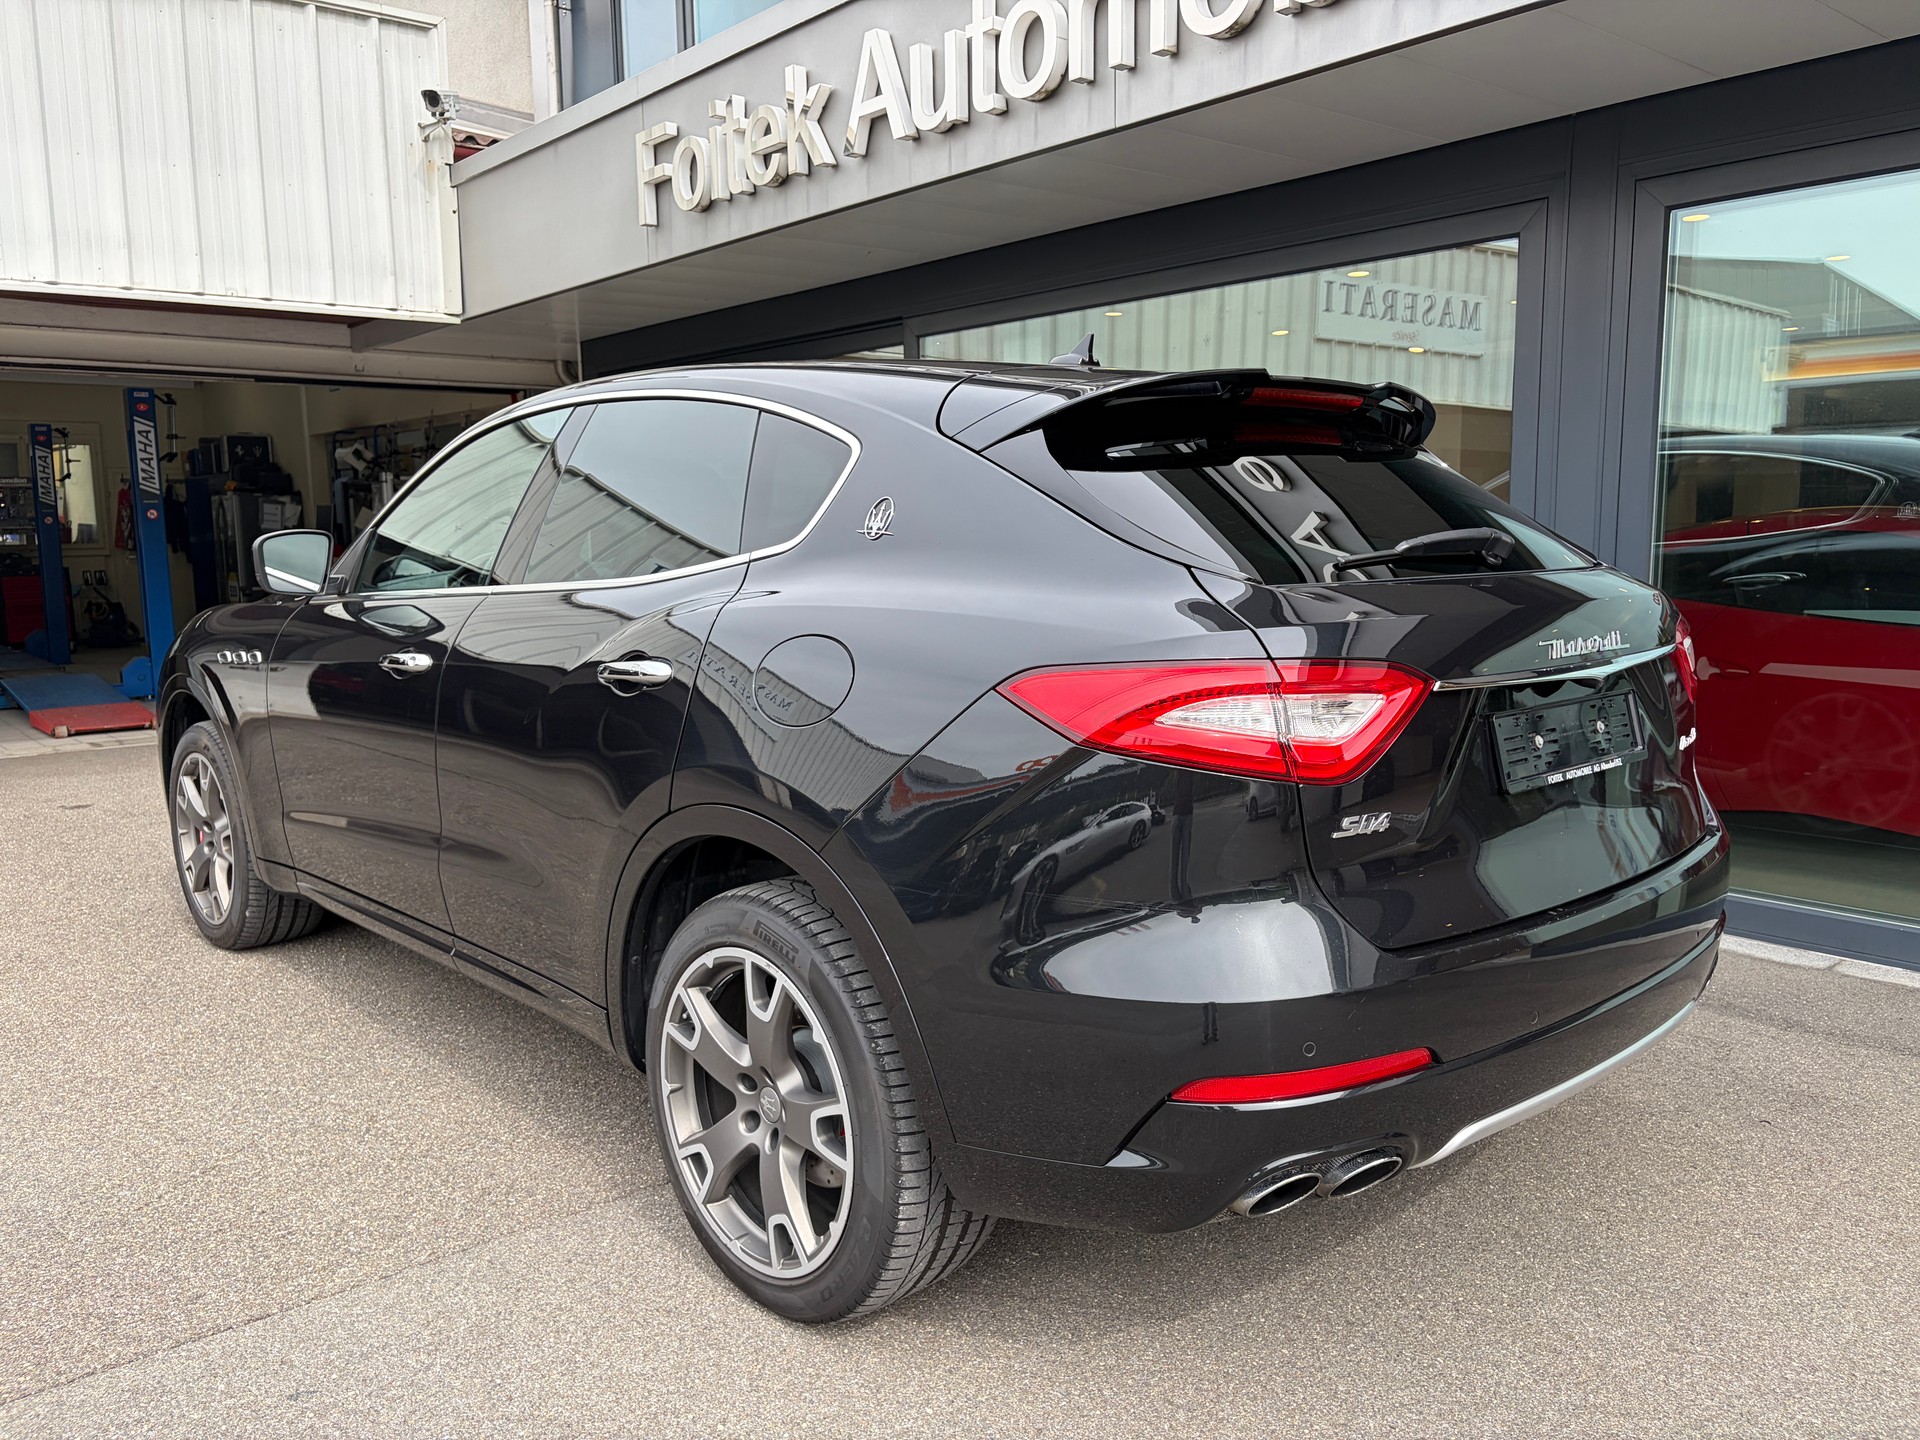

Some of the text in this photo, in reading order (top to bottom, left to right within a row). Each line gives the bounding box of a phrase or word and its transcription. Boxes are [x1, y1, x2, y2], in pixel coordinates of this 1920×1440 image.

[634, 0, 1346, 228] Foitek Autom
[38, 454, 54, 500] MAHA
[137, 429, 157, 486] MAHA
[1536, 630, 1630, 660] Maserati
[1566, 766, 1593, 780] AUTOMOBILE
[1593, 763, 1600, 773] AG
[753, 919, 800, 964] PIRELLI
